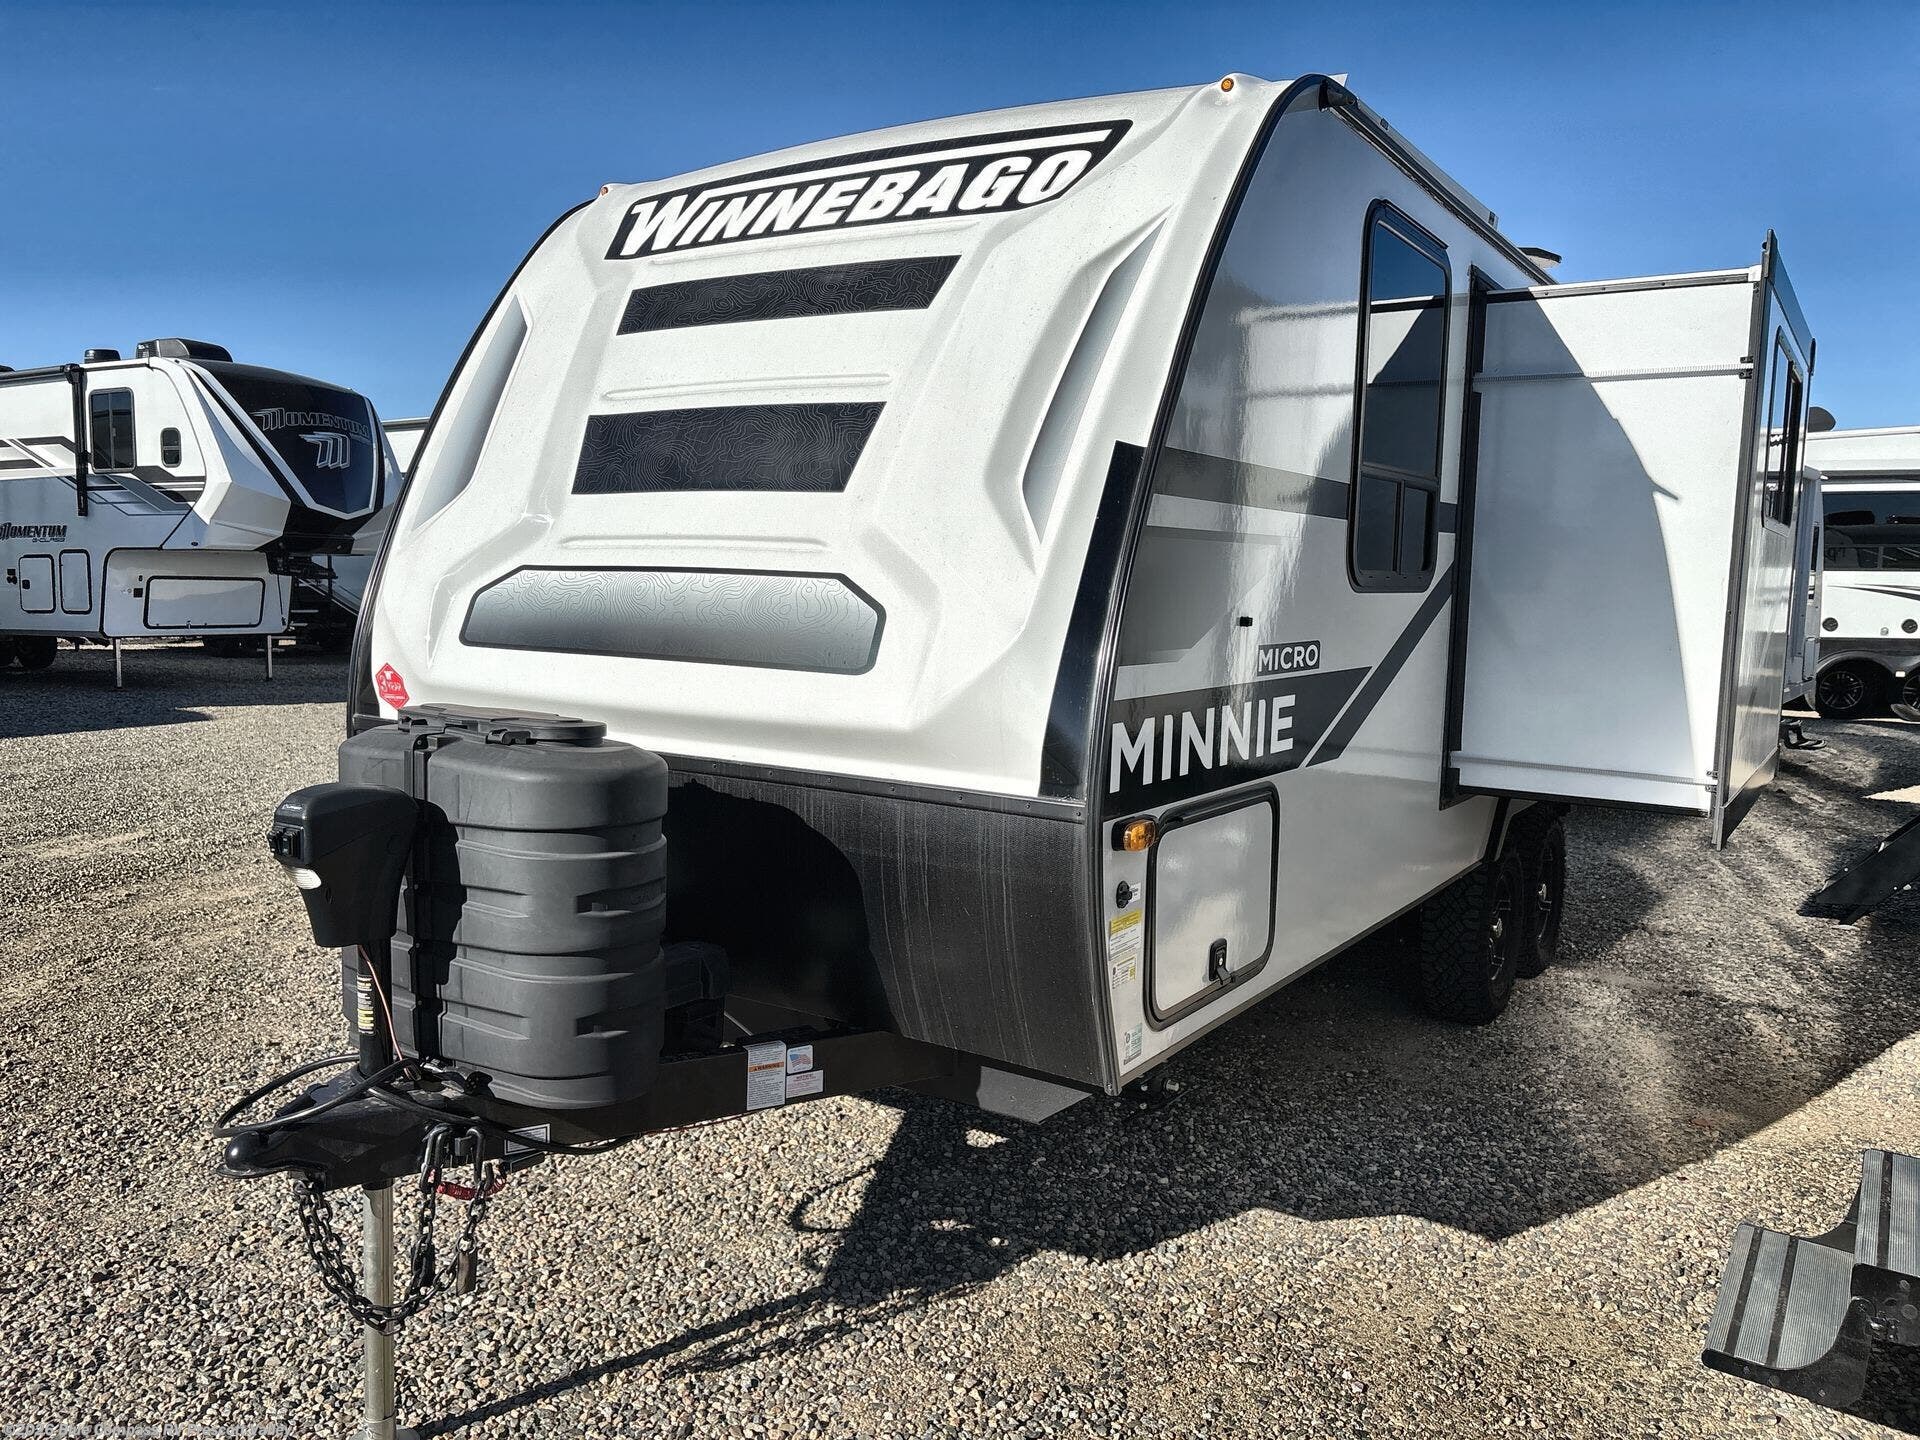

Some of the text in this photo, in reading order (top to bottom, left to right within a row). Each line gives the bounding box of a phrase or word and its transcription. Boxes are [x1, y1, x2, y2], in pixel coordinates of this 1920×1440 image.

[619, 147, 1094, 257] WINNEBAGO
[249, 407, 371, 438] MOMENTUM
[1257, 643, 1319, 673] MICRO
[1109, 694, 1297, 795] MINNIE
